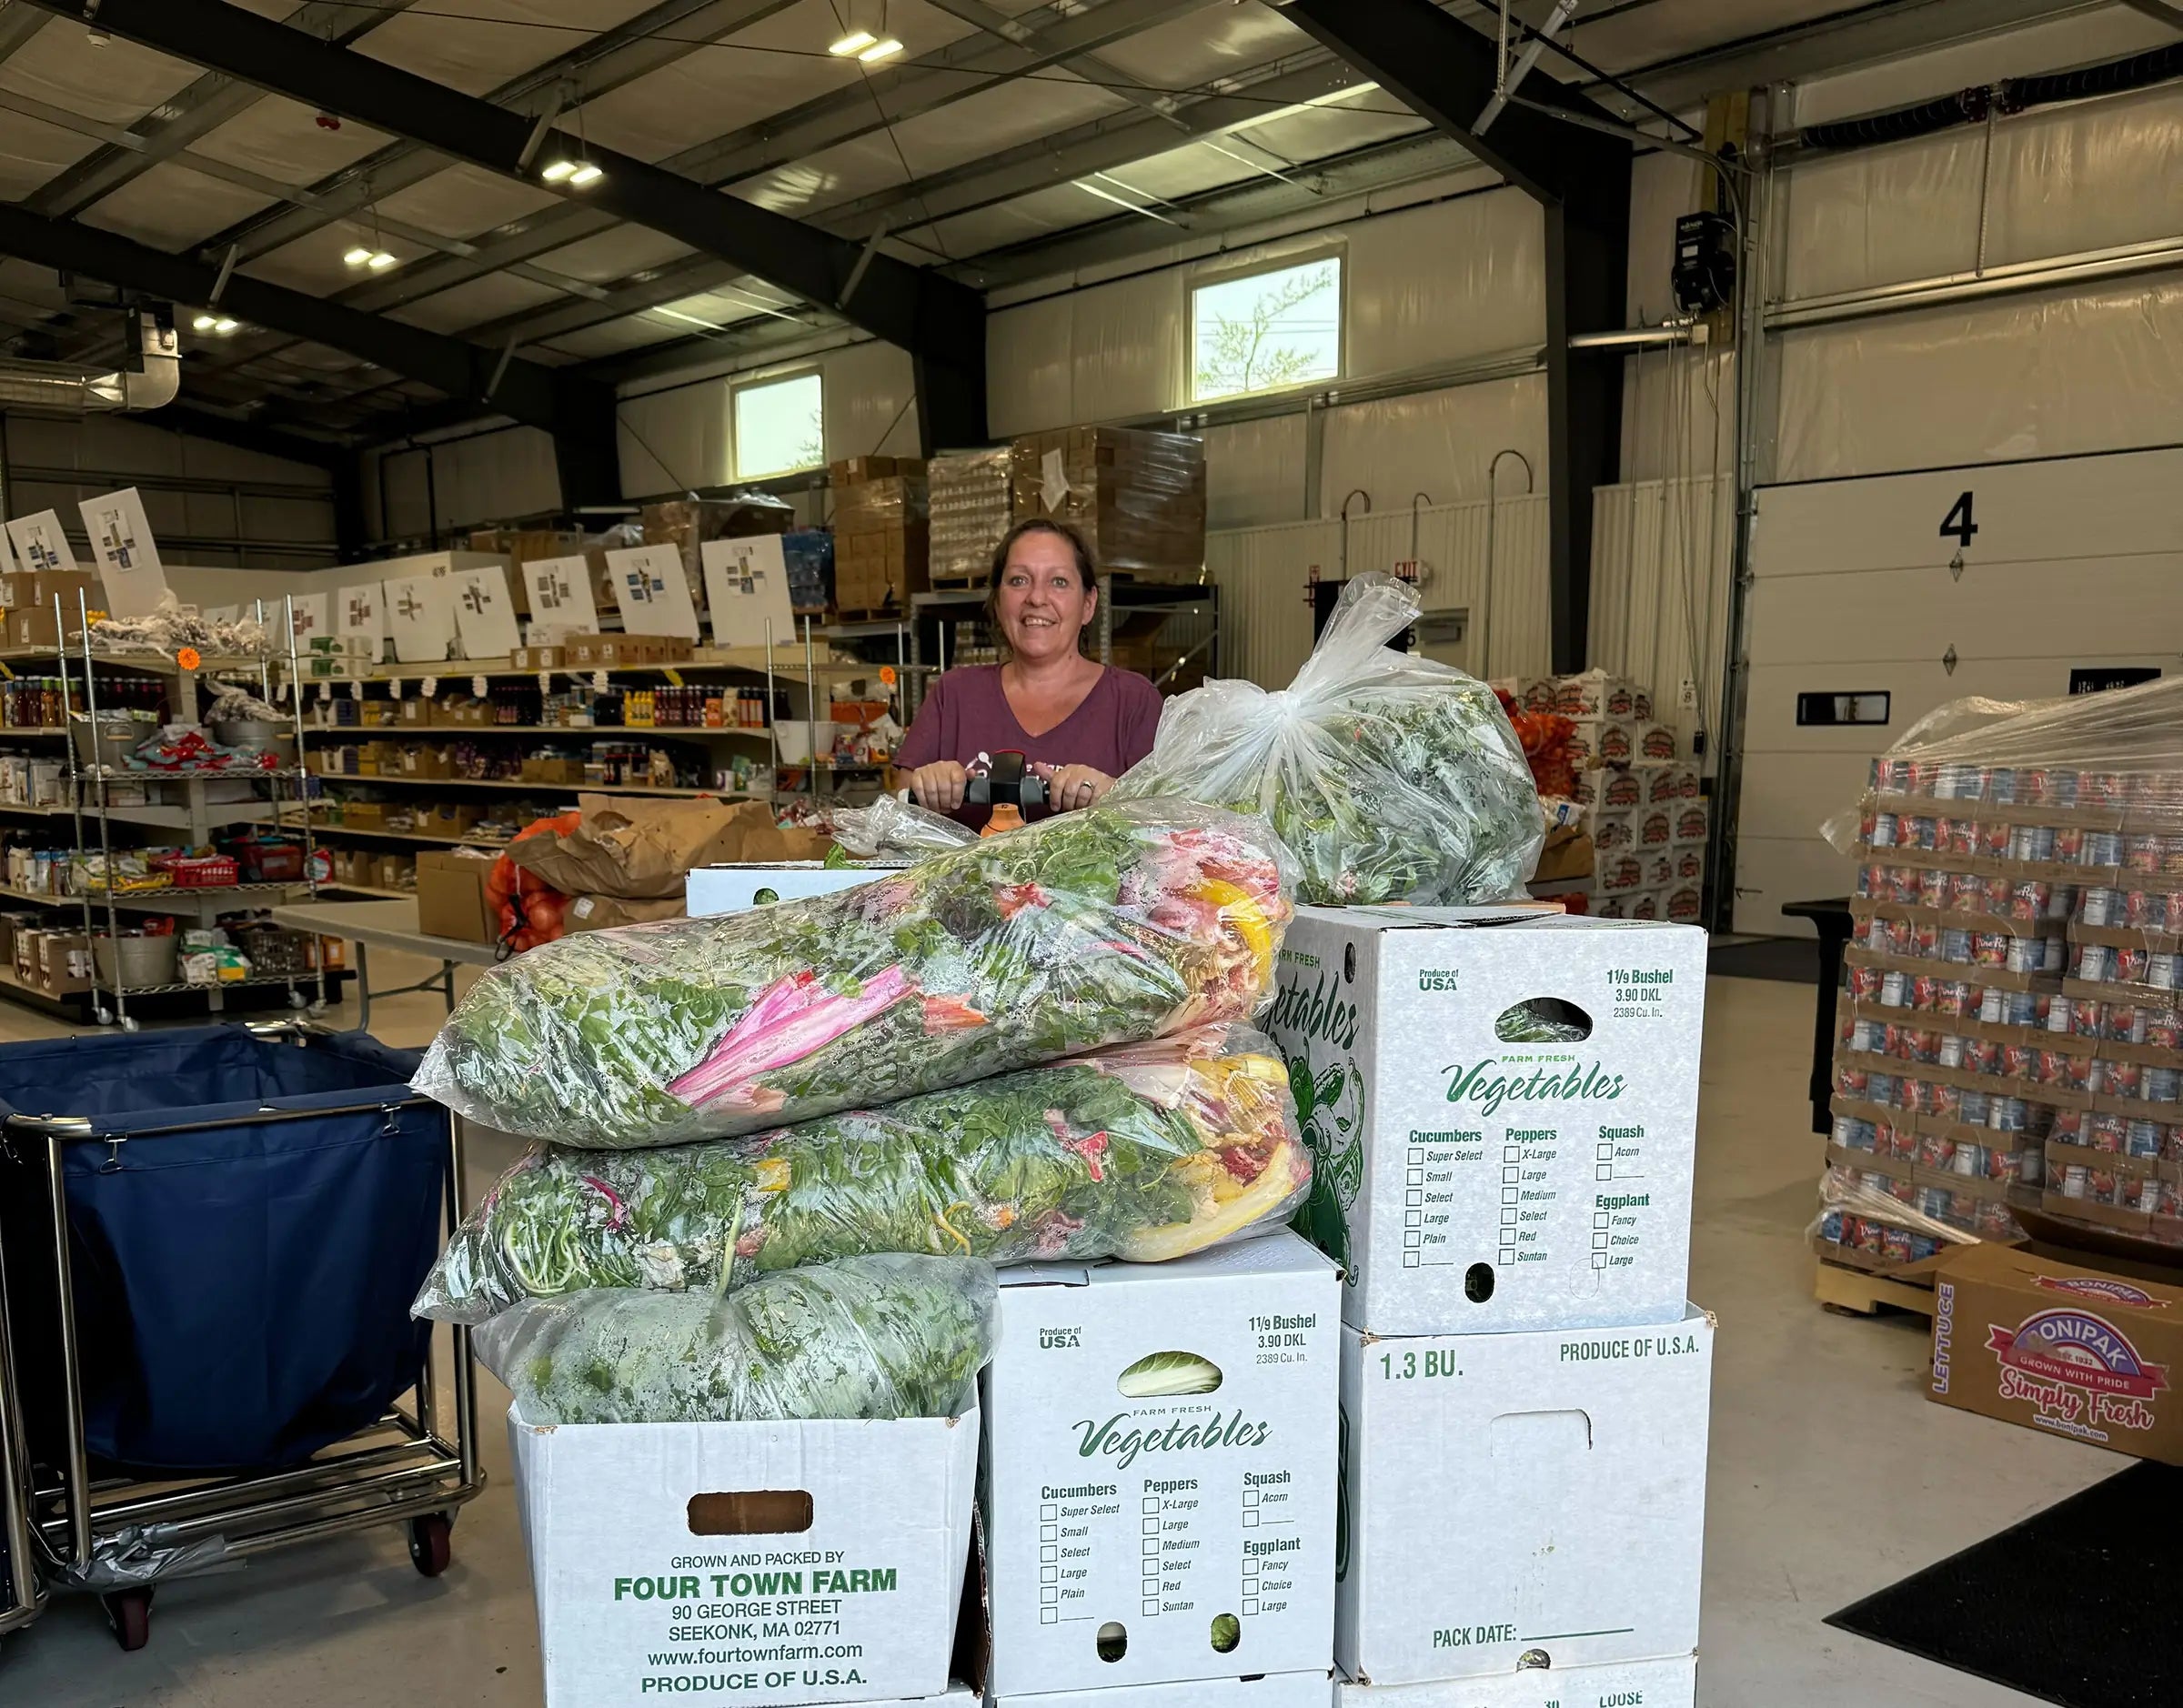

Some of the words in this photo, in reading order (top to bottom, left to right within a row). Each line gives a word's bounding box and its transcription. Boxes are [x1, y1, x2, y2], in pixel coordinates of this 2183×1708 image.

[1939, 491, 1978, 547] 4
[1395, 561, 1418, 578] EXIT
[1294, 951, 1320, 969] FRESH
[1420, 970, 1447, 980] Produce
[1632, 970, 1673, 983] Bushel
[1420, 978, 1456, 990] USA
[1616, 989, 1637, 1001] 3.90
[1641, 989, 1661, 1001] DKL
[1261, 970, 1360, 1050] etables
[1614, 1008, 1635, 1018] 2389
[1636, 1007, 1650, 1017] Cu.
[1652, 1007, 1662, 1017] In.
[1441, 1060, 1627, 1117] Vegetables
[1410, 1130, 1482, 1142] Cucumbers
[1506, 1129, 1556, 1143] Peppers
[1599, 1125, 1644, 1140] Squash
[1427, 1151, 1454, 1163] Super
[1455, 1150, 1483, 1160] Select
[1522, 1150, 1556, 1160] X-Large
[1615, 1147, 1639, 1156] Acorn
[1426, 1171, 1453, 1181] Small
[1522, 1170, 1546, 1181] Large
[1425, 1191, 1453, 1202] Select
[1521, 1191, 1555, 1201] Medium
[1596, 1193, 1650, 1210] Eggplant
[1424, 1211, 1449, 1225] Large
[1520, 1211, 1547, 1221] Select
[1612, 1213, 1636, 1229] Fancy
[1423, 1234, 1446, 1243] Plain
[1519, 1231, 1536, 1241] Red
[1611, 1235, 1639, 1245] Choice
[1517, 1251, 1547, 1261] Suntan
[1609, 1253, 1633, 1266] Large
[1273, 1313, 1315, 1330] Bushel
[1041, 1328, 1071, 1337] Produce
[1074, 1326, 1081, 1334] of
[1934, 1283, 1954, 1393] LETTUCE
[1041, 1335, 1080, 1349] USA
[1259, 1335, 1281, 1348] 3.90
[1284, 1333, 1306, 1346] DKL
[2040, 1319, 2128, 1368] ONIPAK
[1561, 1341, 1629, 1361] PRODUCE
[1635, 1339, 1652, 1357] OF
[1657, 1336, 1698, 1355] U.S.A.
[1257, 1353, 1278, 1363] 2389
[1281, 1353, 1295, 1362] Cu.
[1297, 1352, 1307, 1361] In.
[1381, 1352, 1415, 1379] 1.3
[1425, 1350, 1463, 1377] BU.
[2020, 1356, 2061, 1374] GROWN
[2065, 1368, 2093, 1383] WITH
[2097, 1376, 2129, 1389] PRIDE
[2001, 1368, 2082, 1418] Simply
[2088, 1390, 2153, 1427] Fresh
[1172, 1405, 1211, 1413] FRESH
[2035, 1417, 2107, 1440] www.bonipak.com
[1072, 1410, 1273, 1470] Vegetables
[1144, 1477, 1198, 1494] Peppers
[1244, 1471, 1290, 1487] Squash
[1041, 1483, 1116, 1499] Cucumbers
[1262, 1493, 1288, 1502] Acorn
[1061, 1507, 1088, 1518] Super
[1091, 1504, 1120, 1514] Select
[1162, 1500, 1198, 1510] X-Large
[1061, 1527, 1088, 1537] Small
[1162, 1521, 1188, 1531] Large
[1162, 1540, 1200, 1550] Medium
[1244, 1538, 1300, 1555] Eggplant
[1061, 1547, 1090, 1557] Select
[671, 1555, 726, 1569] GROWN
[730, 1554, 760, 1566] AND
[766, 1552, 820, 1565] PACKED
[825, 1552, 844, 1562] BY
[1162, 1561, 1191, 1571] Select
[1263, 1558, 1288, 1571] Fancy
[1061, 1569, 1087, 1579] Large
[615, 1576, 700, 1601] FOUR
[710, 1572, 802, 1597] TOWN
[813, 1569, 896, 1593] FARM
[1162, 1581, 1181, 1591] Red
[1263, 1581, 1292, 1591] Choice
[1061, 1589, 1084, 1599] Plain
[672, 1605, 691, 1620] 90
[698, 1603, 771, 1619] GEORGE
[777, 1600, 842, 1615] STREET
[1162, 1599, 1193, 1612] Suntan
[1262, 1599, 1287, 1612] Large
[669, 1623, 757, 1641] SEEKONK,
[763, 1623, 790, 1637] MA
[795, 1621, 839, 1636] 02771
[1434, 1628, 1471, 1648] PACK
[1476, 1624, 1516, 1643] DATE:
[648, 1644, 861, 1665] www.fourtownfarm.com
[642, 1673, 758, 1693] PRODUCE
[765, 1672, 796, 1687] OF
[803, 1669, 867, 1685] U.S.A.
[1599, 1691, 1643, 1708] LOOSE
